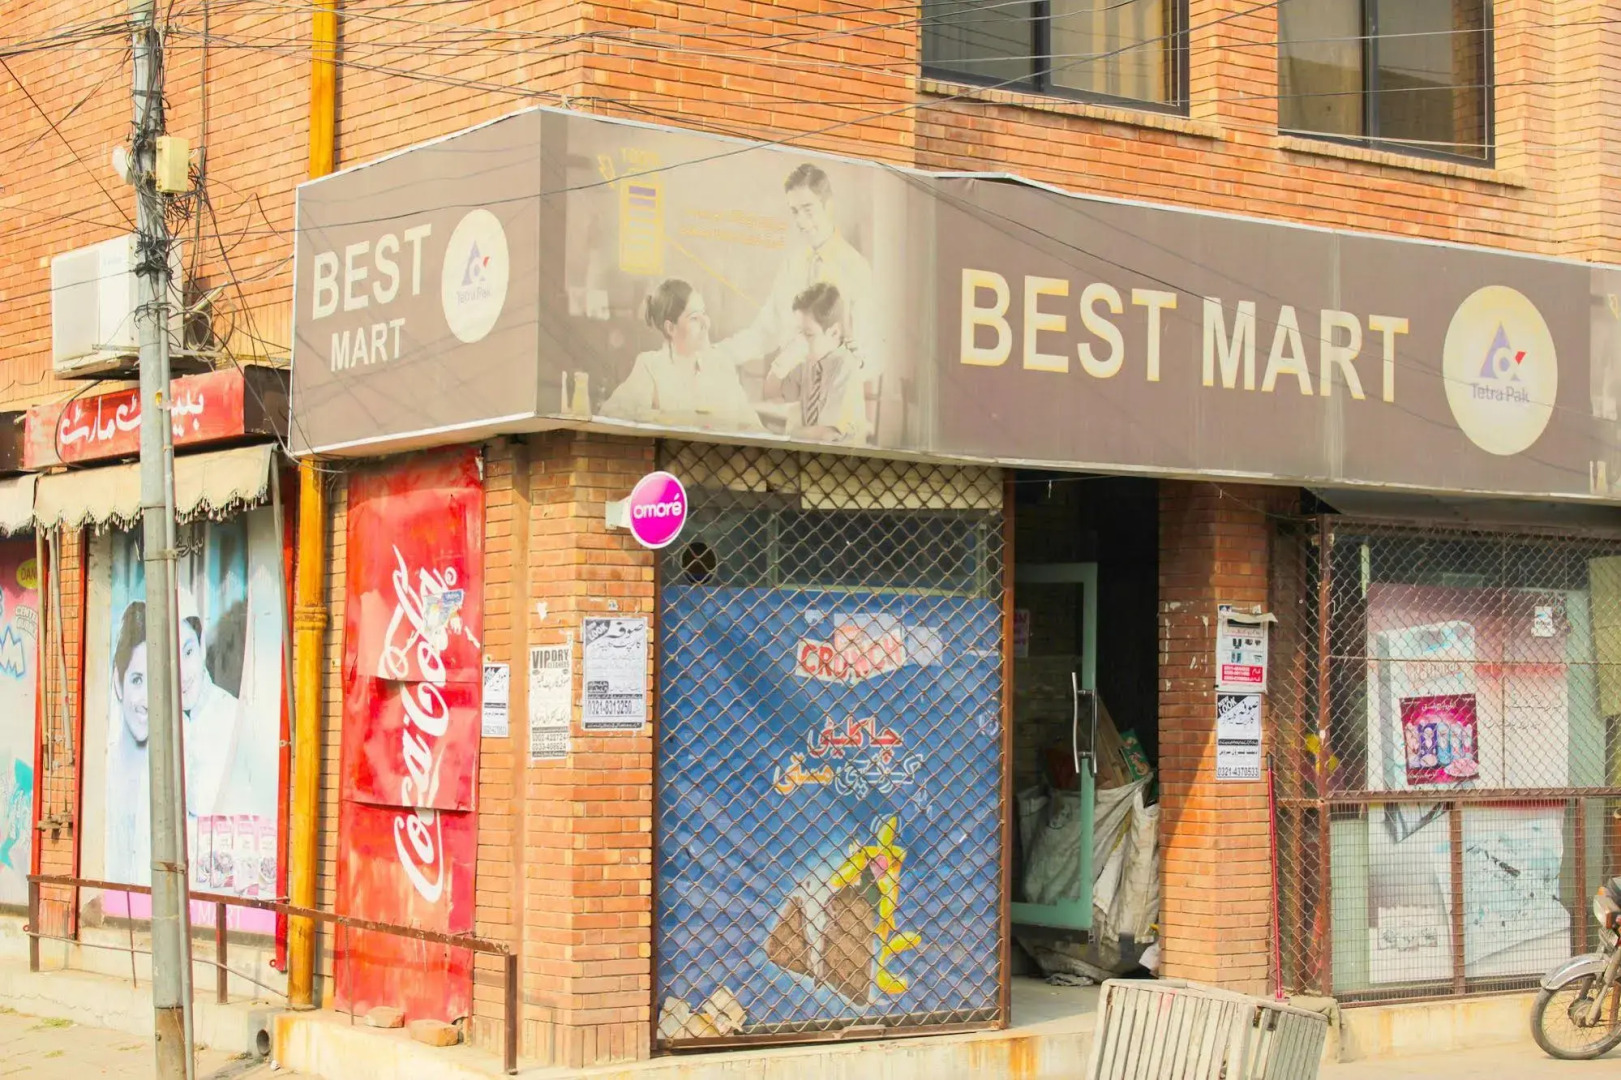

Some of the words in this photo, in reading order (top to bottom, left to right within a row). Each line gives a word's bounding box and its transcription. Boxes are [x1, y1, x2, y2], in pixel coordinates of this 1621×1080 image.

[313, 223, 432, 320] BEST
[330, 318, 406, 372] MART
[960, 268, 1177, 382] BEST
[1202, 296, 1410, 402] MART
[1470, 382, 1503, 401] Tetra
[1505, 386, 1530, 403] Pak
[532, 650, 551, 669] VIP
[551, 649, 570, 662] DRY
[1218, 697, 1238, 714] LOOK
